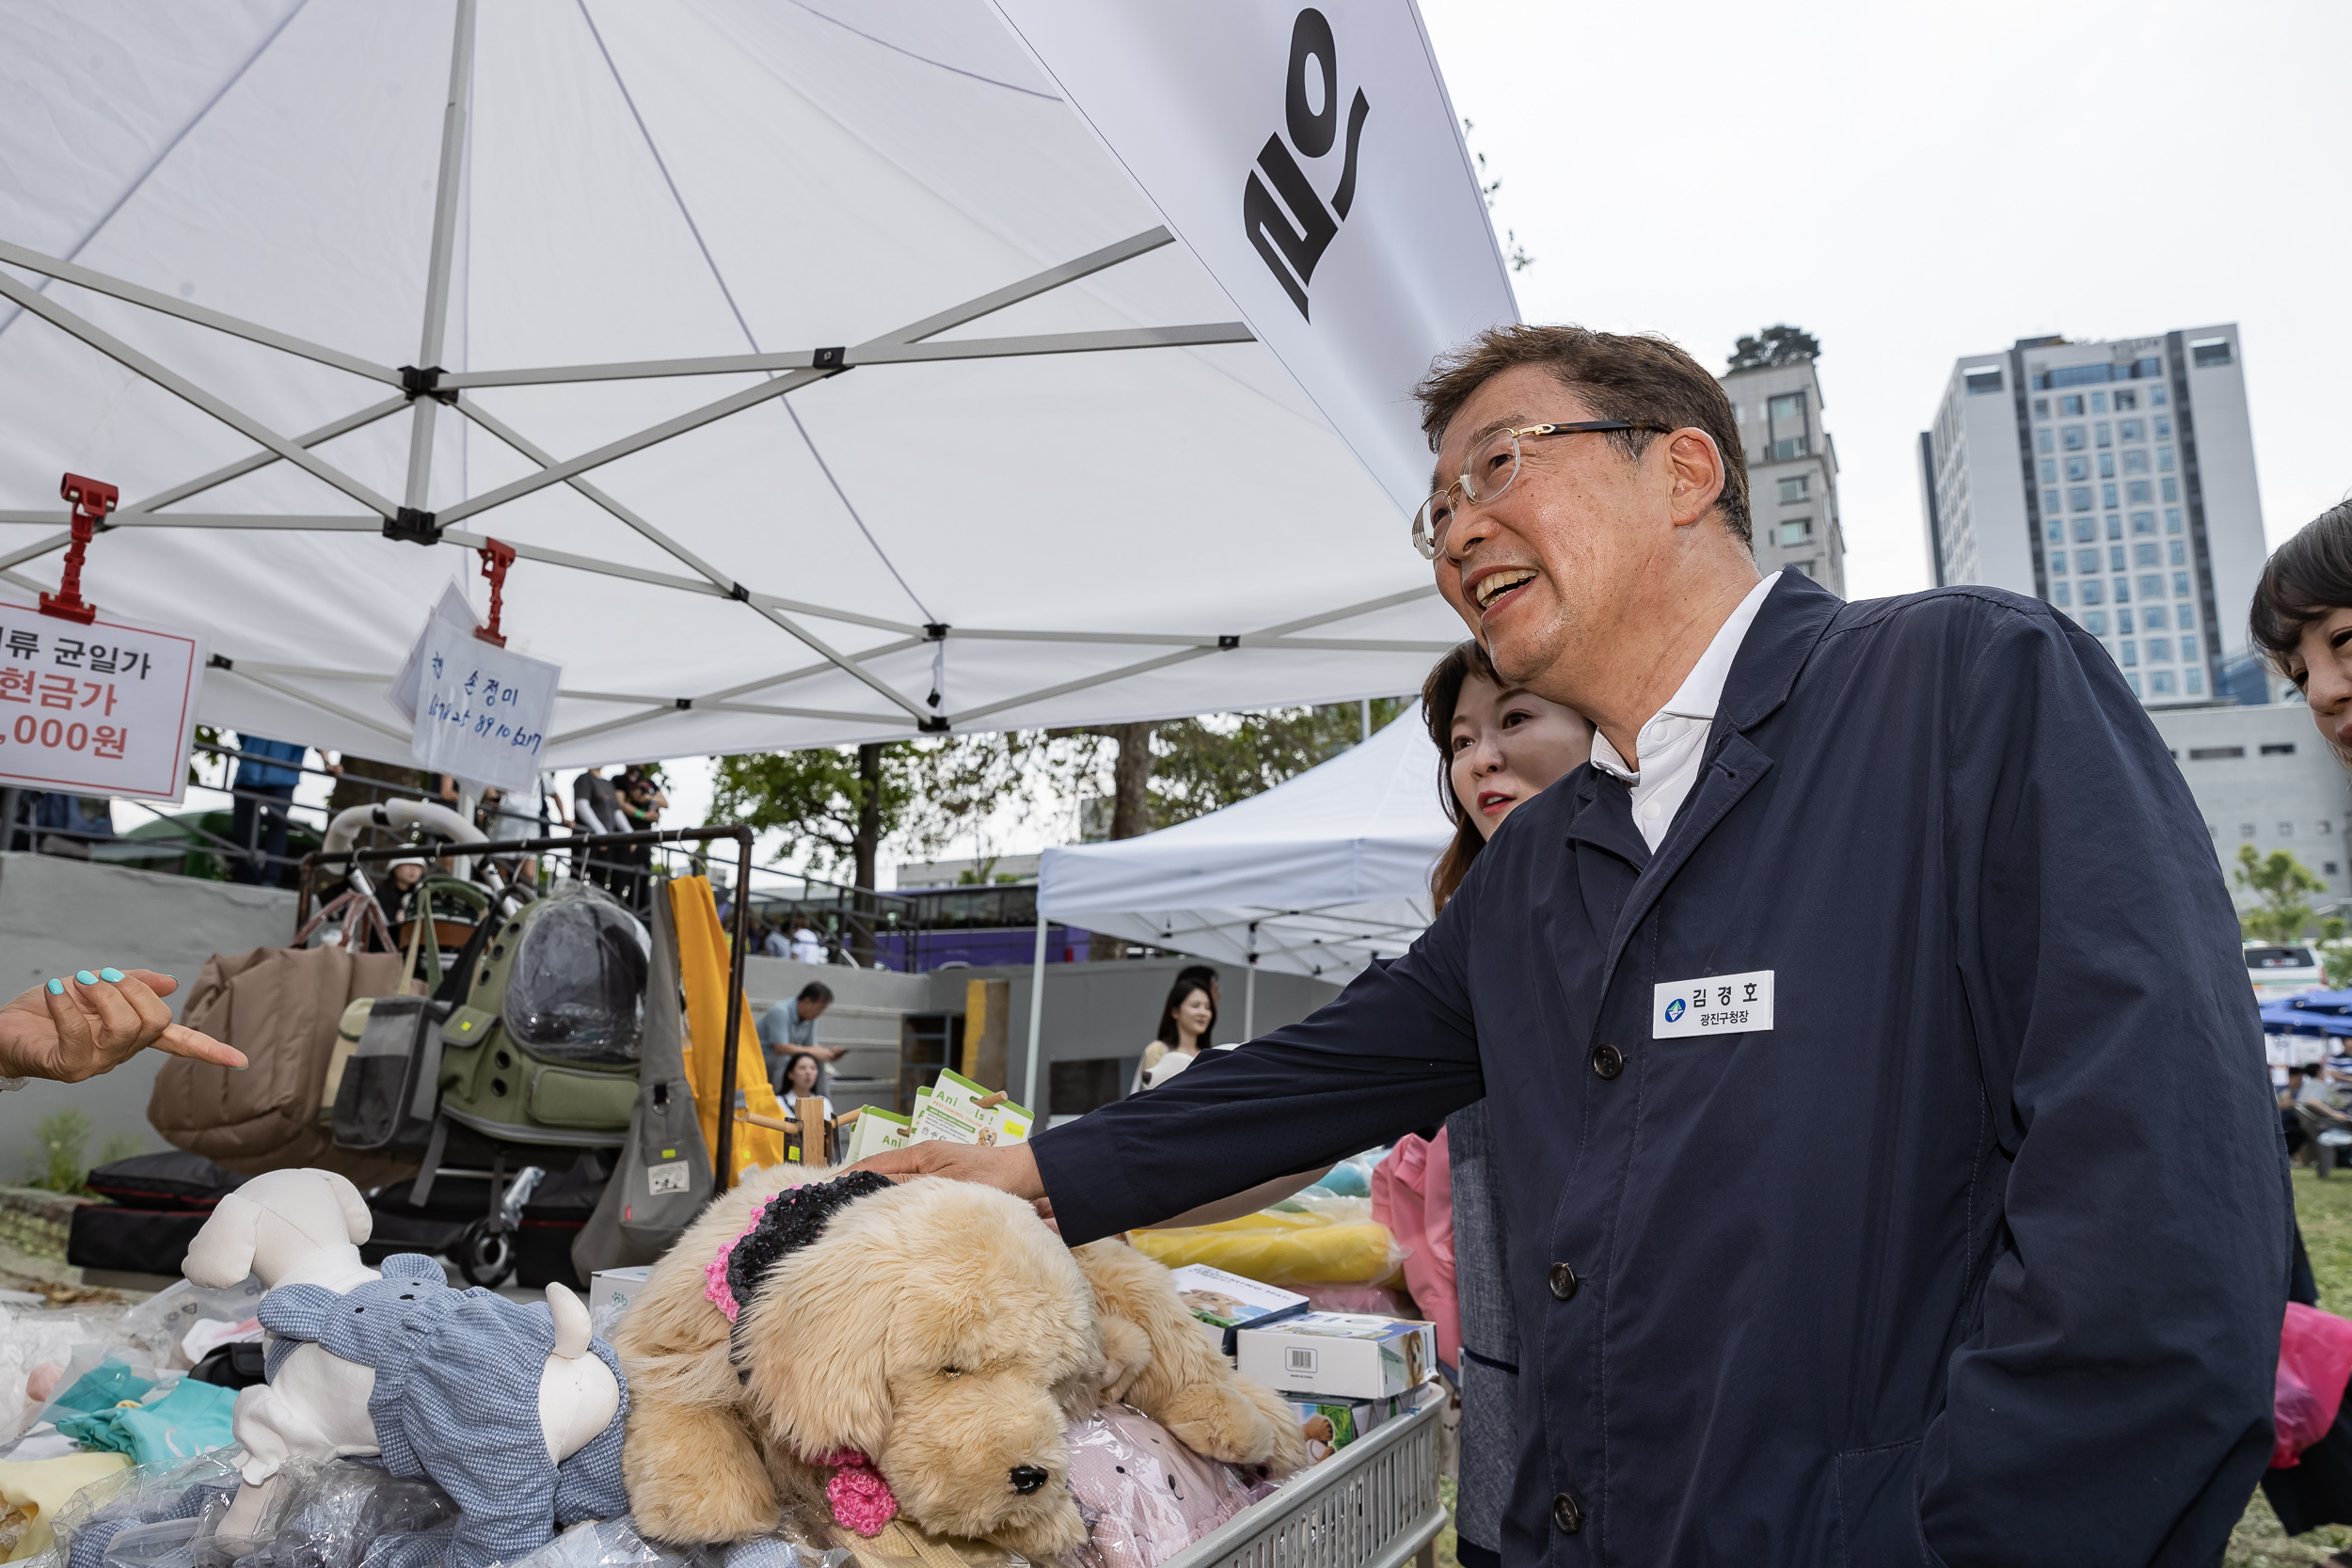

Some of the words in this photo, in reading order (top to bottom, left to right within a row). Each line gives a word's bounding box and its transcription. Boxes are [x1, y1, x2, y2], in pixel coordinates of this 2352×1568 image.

[0, 626, 40, 659] 류
[54, 638, 151, 680] 균일가
[0, 667, 118, 717] 현금가
[1700, 1009, 1750, 1027] 광진구청장
